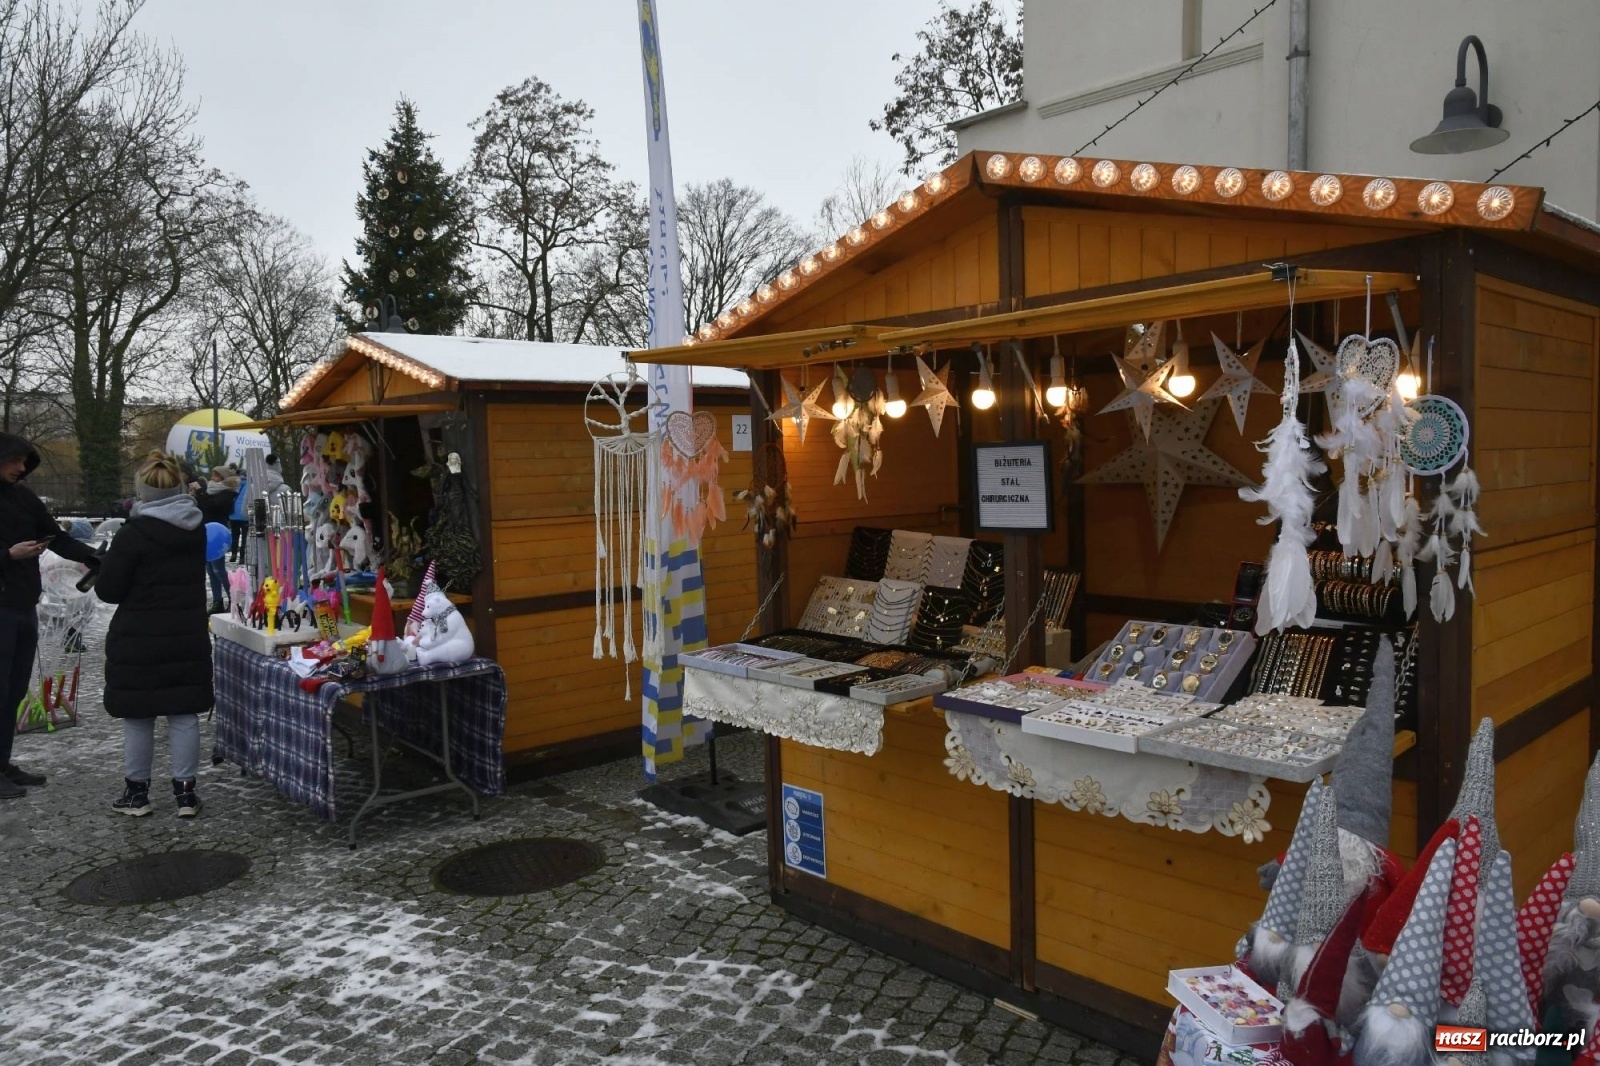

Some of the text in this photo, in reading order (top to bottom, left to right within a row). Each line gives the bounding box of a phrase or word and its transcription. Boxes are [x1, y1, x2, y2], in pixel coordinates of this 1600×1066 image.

[736, 423, 748, 435] 22
[994, 455, 1032, 468] BIŻUTERIA
[1001, 477, 1020, 486] STAL
